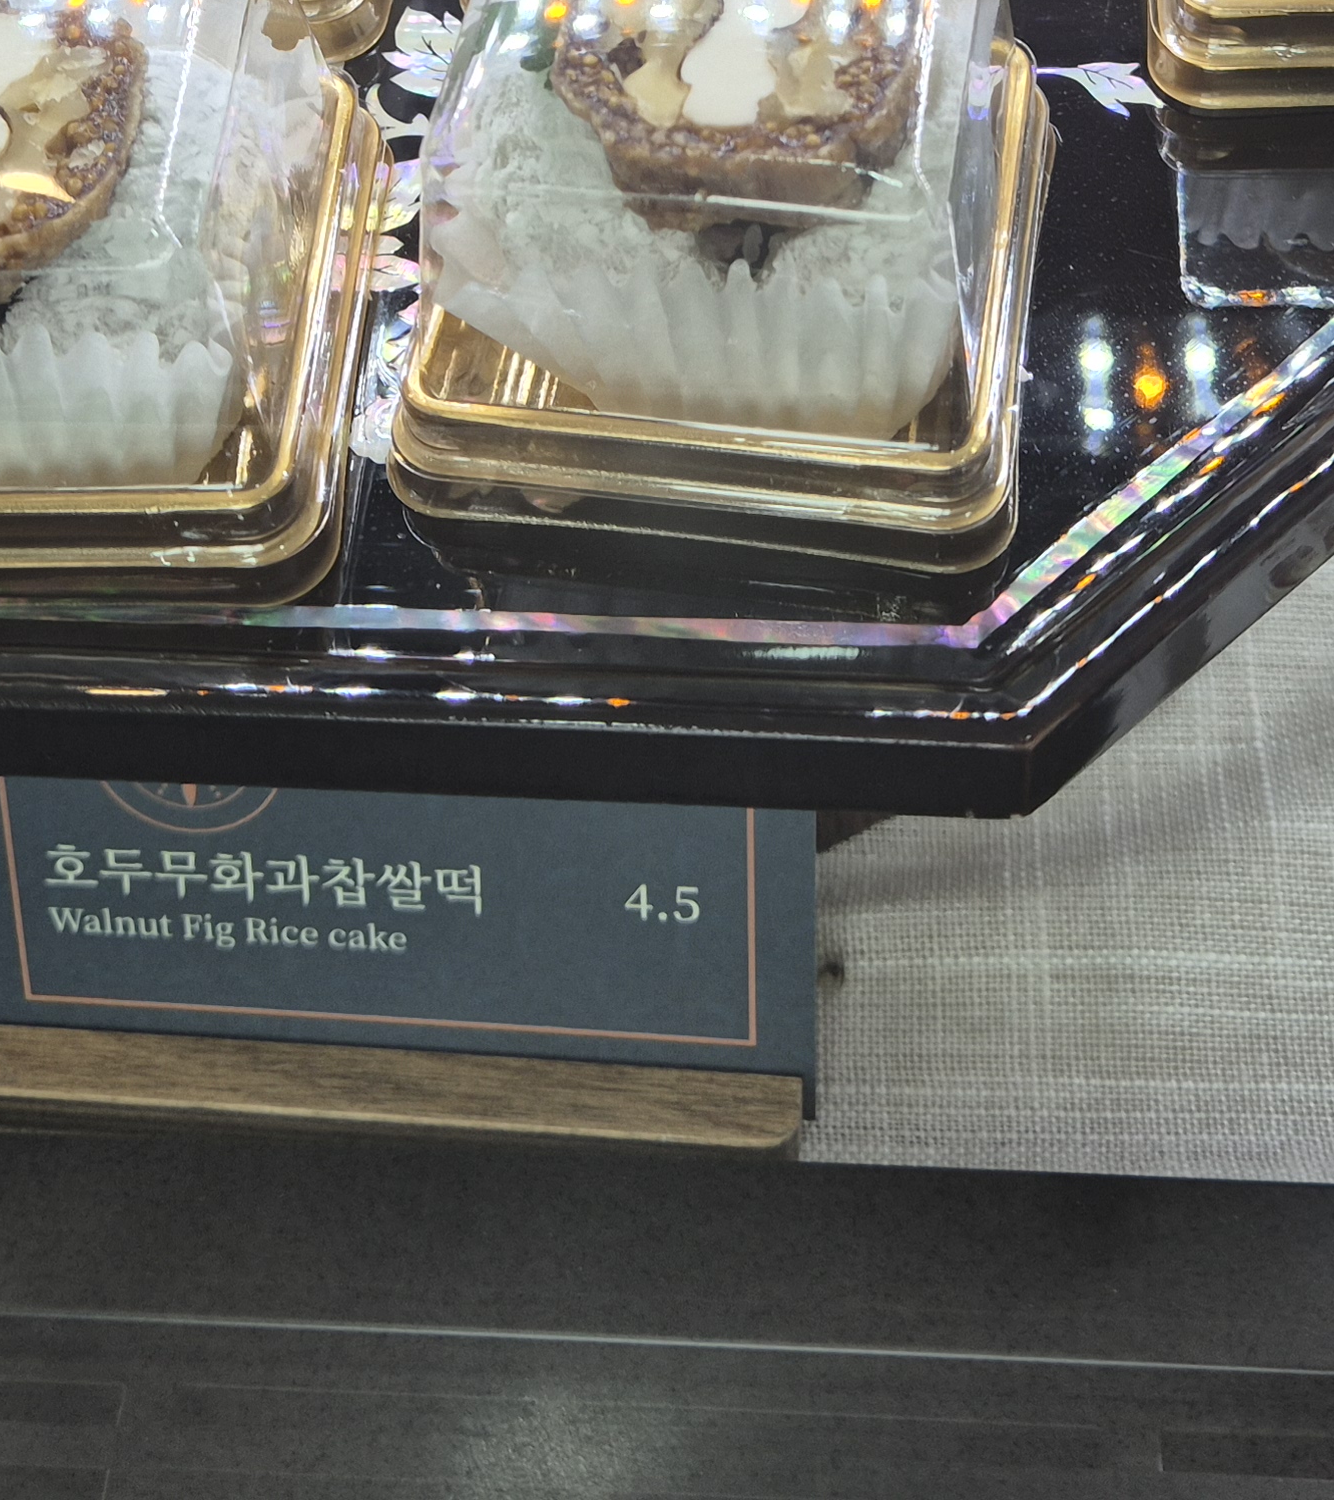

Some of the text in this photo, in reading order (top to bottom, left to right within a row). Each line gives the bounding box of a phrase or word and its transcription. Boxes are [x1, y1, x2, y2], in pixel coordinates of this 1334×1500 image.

[44, 843, 484, 915] 호두무화과찹쌀떡
[623, 883, 702, 924] 4.5
[47, 905, 408, 953] Walnut Fig Rice cake
